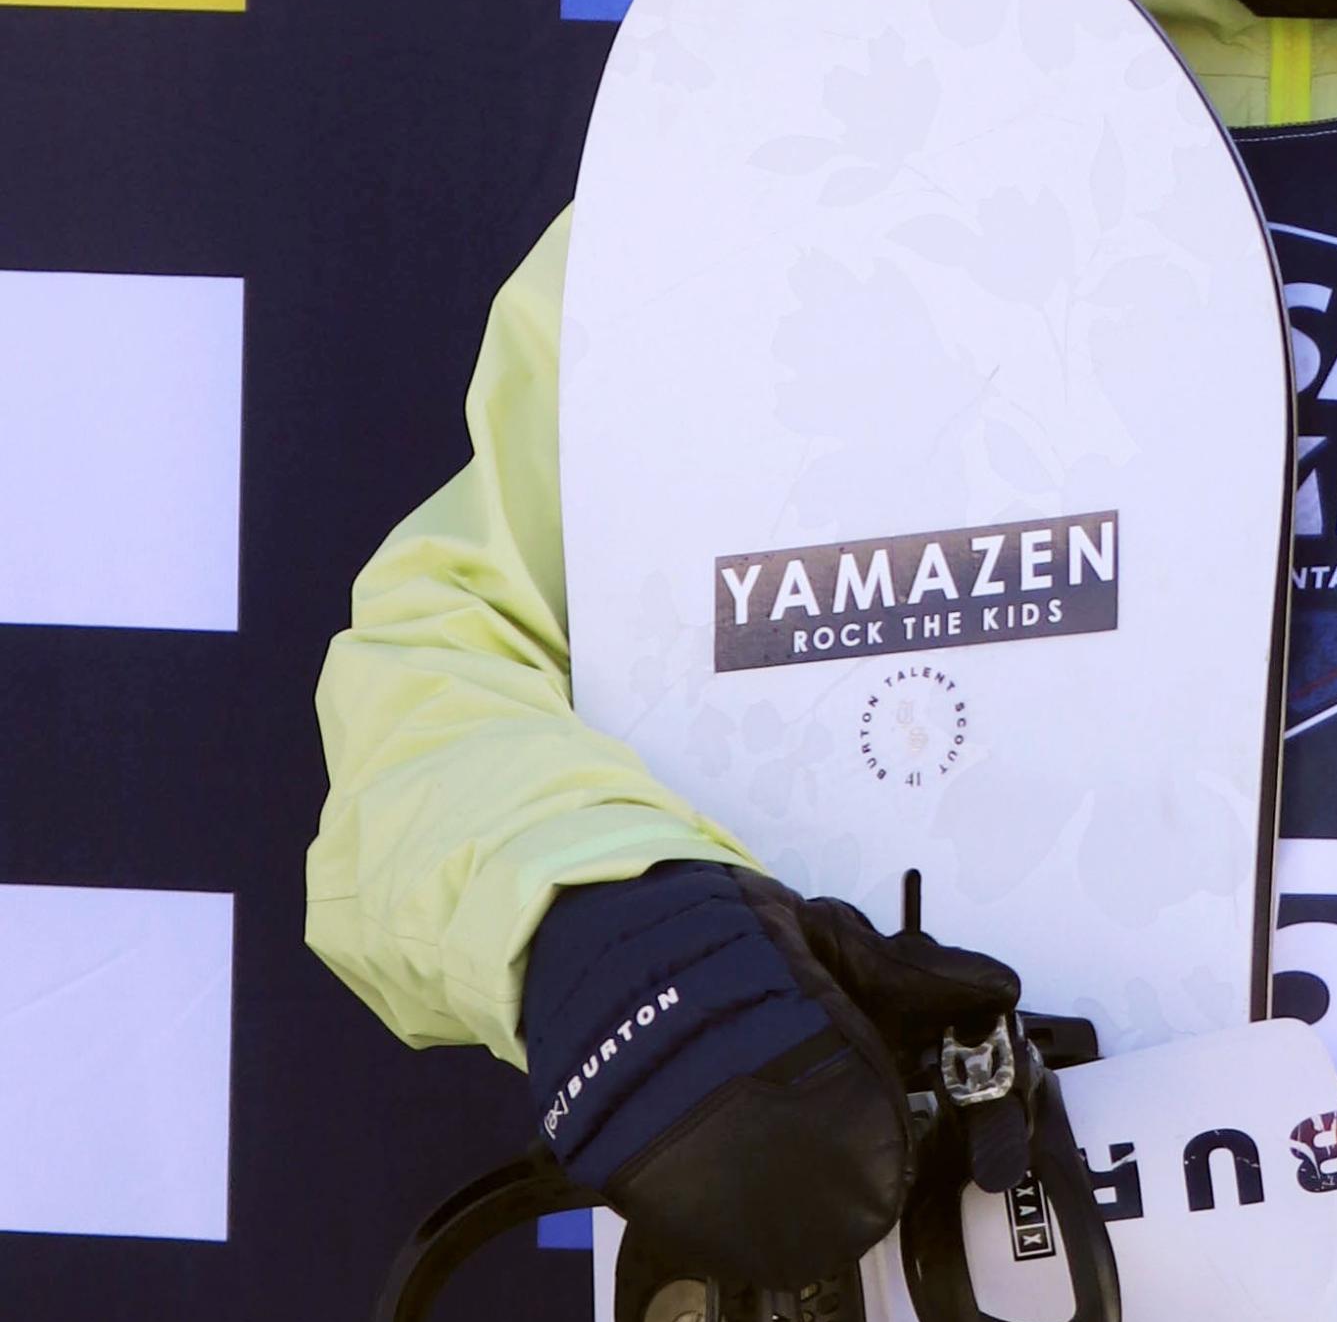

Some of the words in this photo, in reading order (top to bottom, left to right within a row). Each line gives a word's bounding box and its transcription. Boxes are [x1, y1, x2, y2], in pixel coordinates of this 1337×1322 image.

[720, 521, 1116, 625] YAMAZEN
[793, 621, 884, 654] ROCK
[903, 611, 962, 640] THE
[984, 599, 1064, 632] KIDS
[860, 695, 887, 780] BURTON
[884, 666, 956, 692] TALENT
[938, 702, 967, 775] SCOUT
[567, 987, 679, 1099] BURTON
